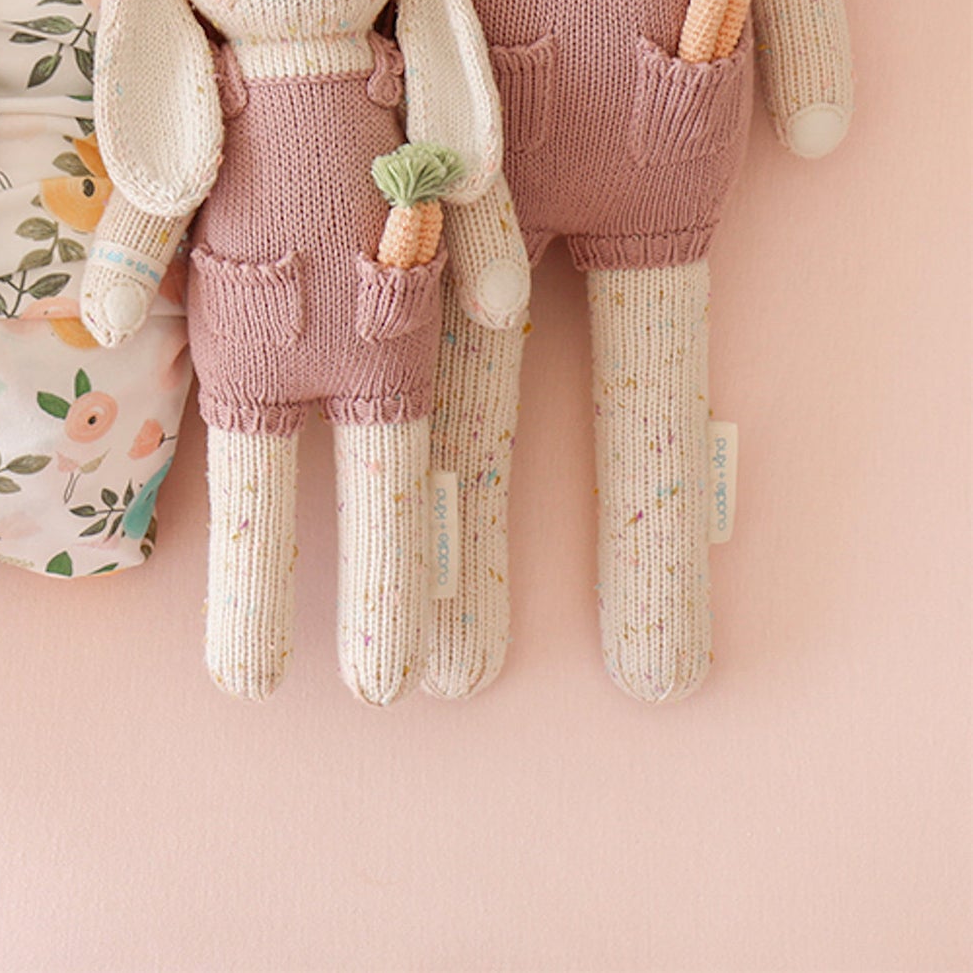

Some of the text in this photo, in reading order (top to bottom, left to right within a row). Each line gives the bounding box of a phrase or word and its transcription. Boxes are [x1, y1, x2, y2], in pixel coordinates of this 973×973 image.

[712, 438, 726, 469] kind
[433, 487, 447, 520] kind
[715, 482, 727, 531] cuddle
[436, 533, 449, 585] cuddle
